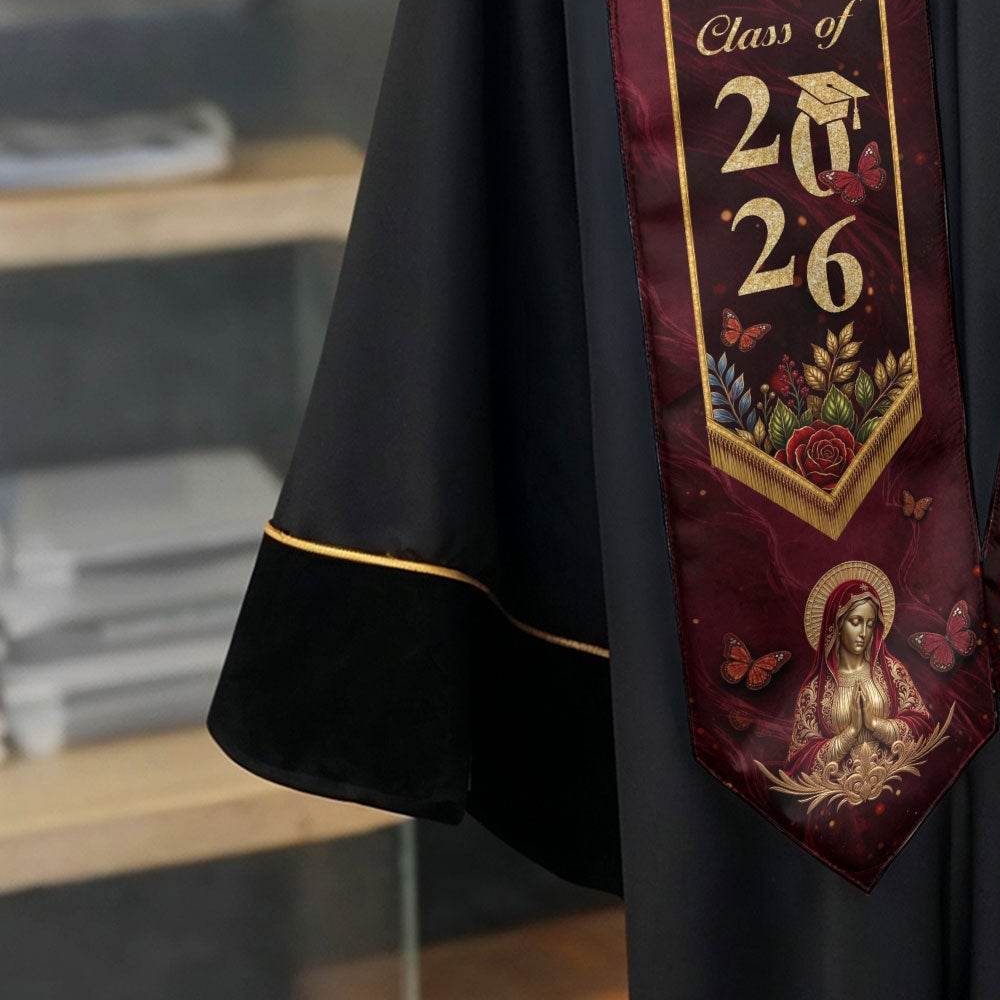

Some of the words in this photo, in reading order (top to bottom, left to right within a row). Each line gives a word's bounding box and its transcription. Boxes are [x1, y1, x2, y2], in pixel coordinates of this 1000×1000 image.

[696, 13, 792, 56] Class
[714, 75, 851, 197] 20
[731, 196, 863, 313] 26
